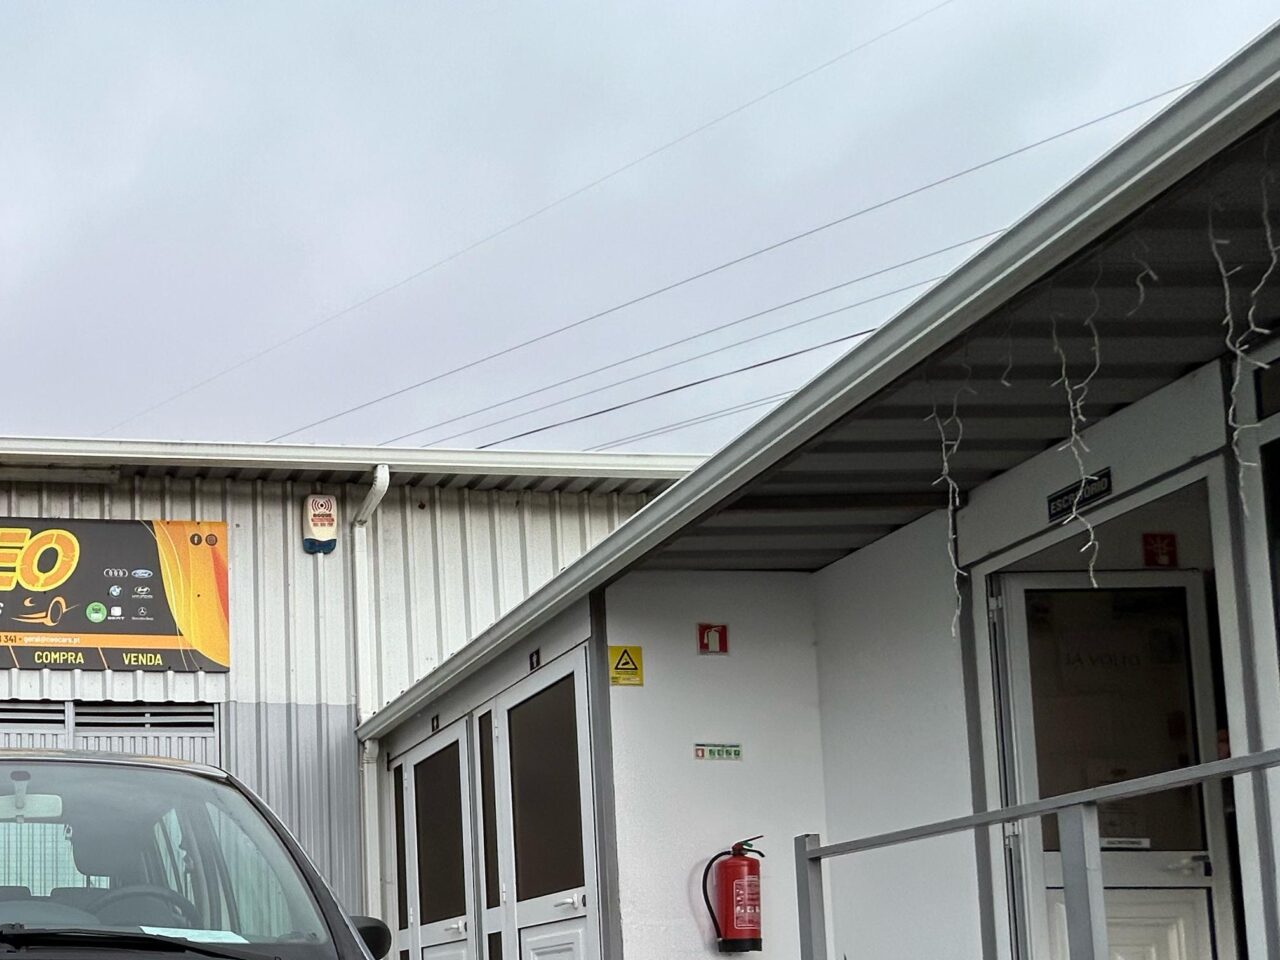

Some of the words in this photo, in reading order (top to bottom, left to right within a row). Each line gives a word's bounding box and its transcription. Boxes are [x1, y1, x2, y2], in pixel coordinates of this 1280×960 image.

[3, 635, 17, 644] 341
[34, 651, 85, 664] COMPRA
[122, 652, 163, 666] VENDA
